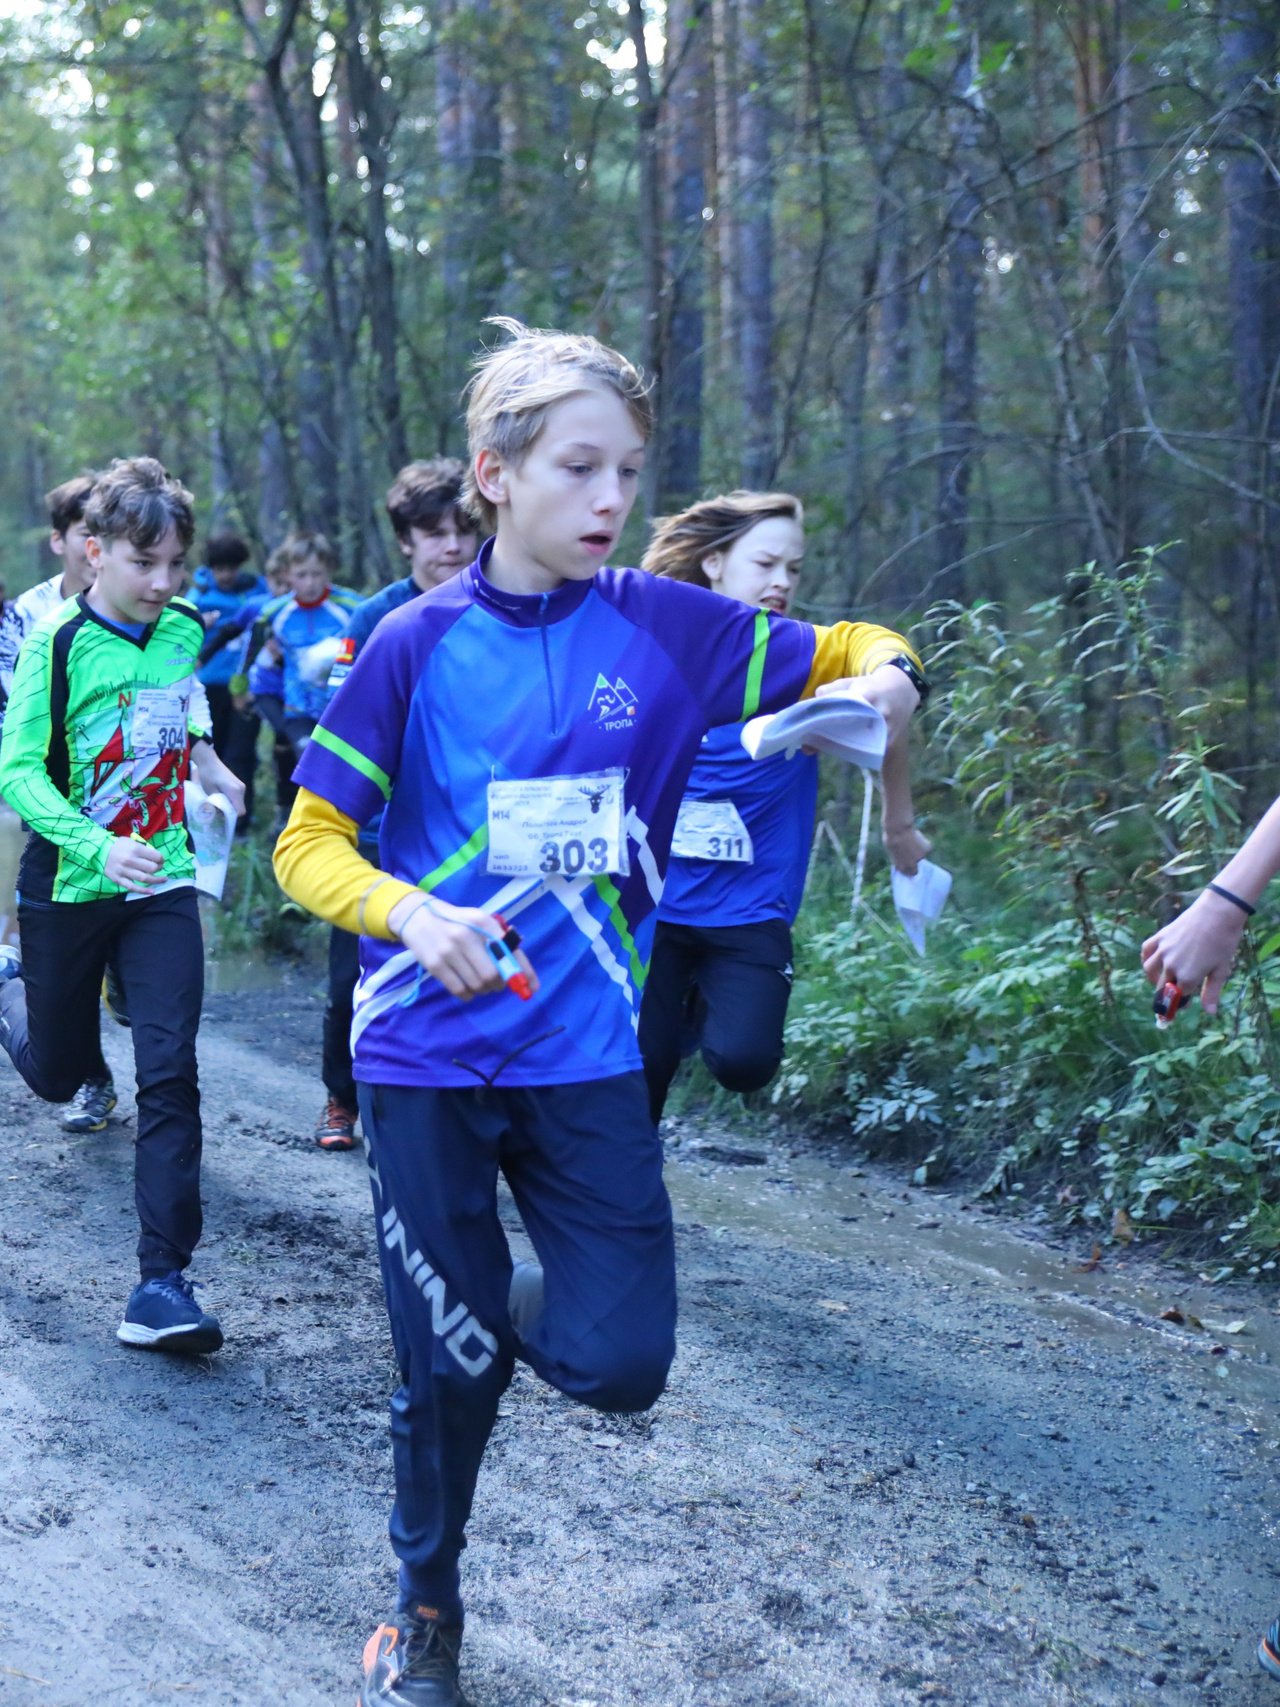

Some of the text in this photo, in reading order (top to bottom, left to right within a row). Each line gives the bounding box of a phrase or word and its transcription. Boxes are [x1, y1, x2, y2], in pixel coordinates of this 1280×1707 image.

[604, 719, 634, 731] ТРОПА
[157, 727, 184, 748] 304
[539, 837, 609, 874] 303
[707, 836, 743, 858] 311
